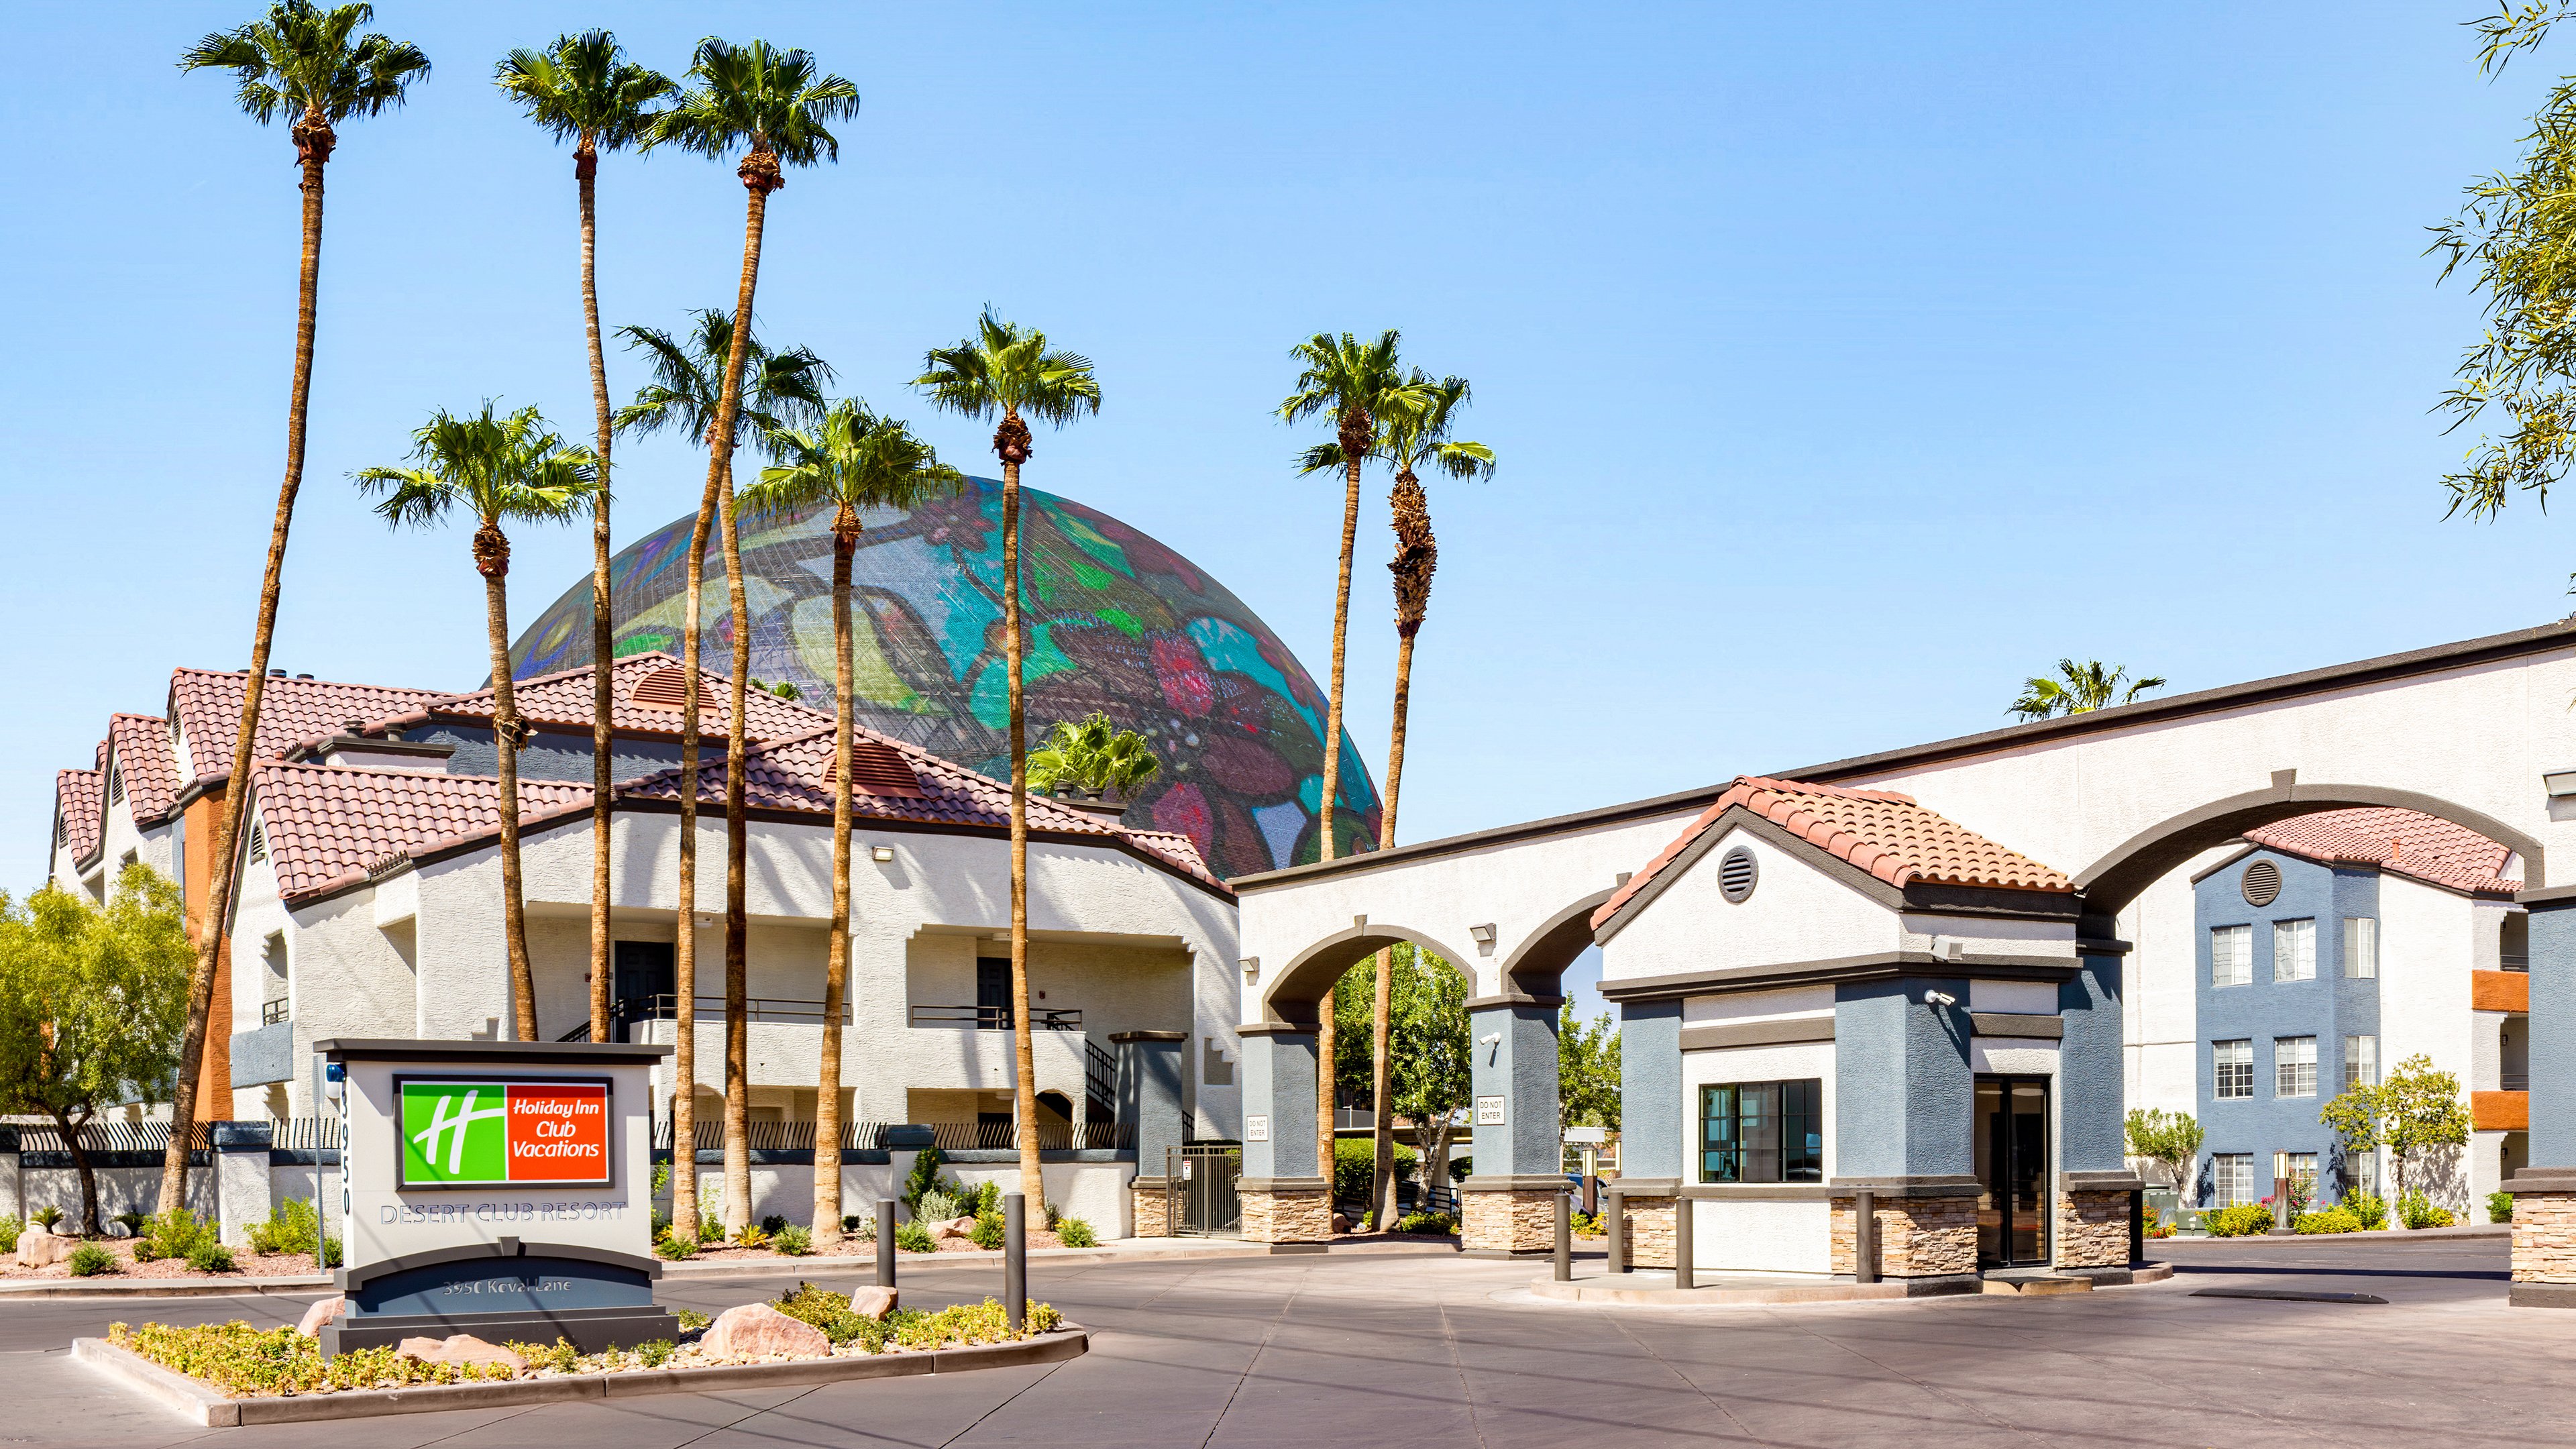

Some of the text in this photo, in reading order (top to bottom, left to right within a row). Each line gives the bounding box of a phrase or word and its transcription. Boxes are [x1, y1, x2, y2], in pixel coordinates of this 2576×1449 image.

[513, 1099, 599, 1118] Holiday Inn
[1481, 1112, 1501, 1120] ENTER
[536, 1120, 576, 1138] Club
[513, 1140, 599, 1157] Vacations
[381, 1201, 626, 1224] DESERT CLUB RESORT
[443, 1277, 572, 1295] 3950 Koval Lane
